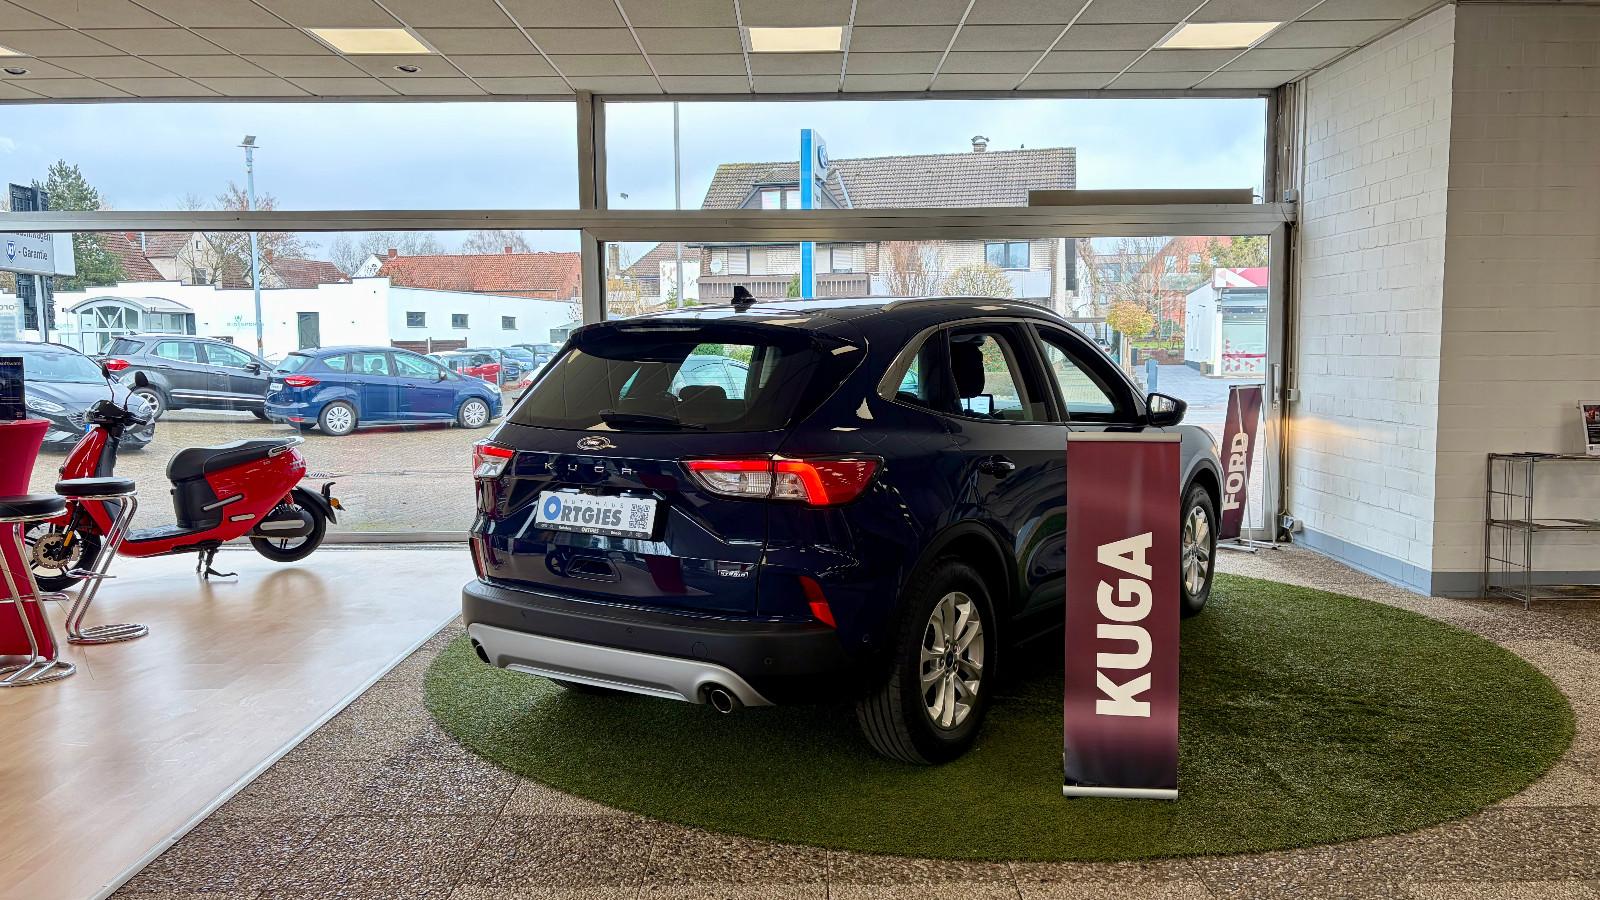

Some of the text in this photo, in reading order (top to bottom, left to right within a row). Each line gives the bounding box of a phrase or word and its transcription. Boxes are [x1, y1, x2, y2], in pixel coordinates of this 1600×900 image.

[1223, 432, 1249, 511] FORD
[543, 495, 622, 527] ORTGIES
[564, 499, 624, 509] AUTOHAUS
[1095, 531, 1153, 718] KUGA
